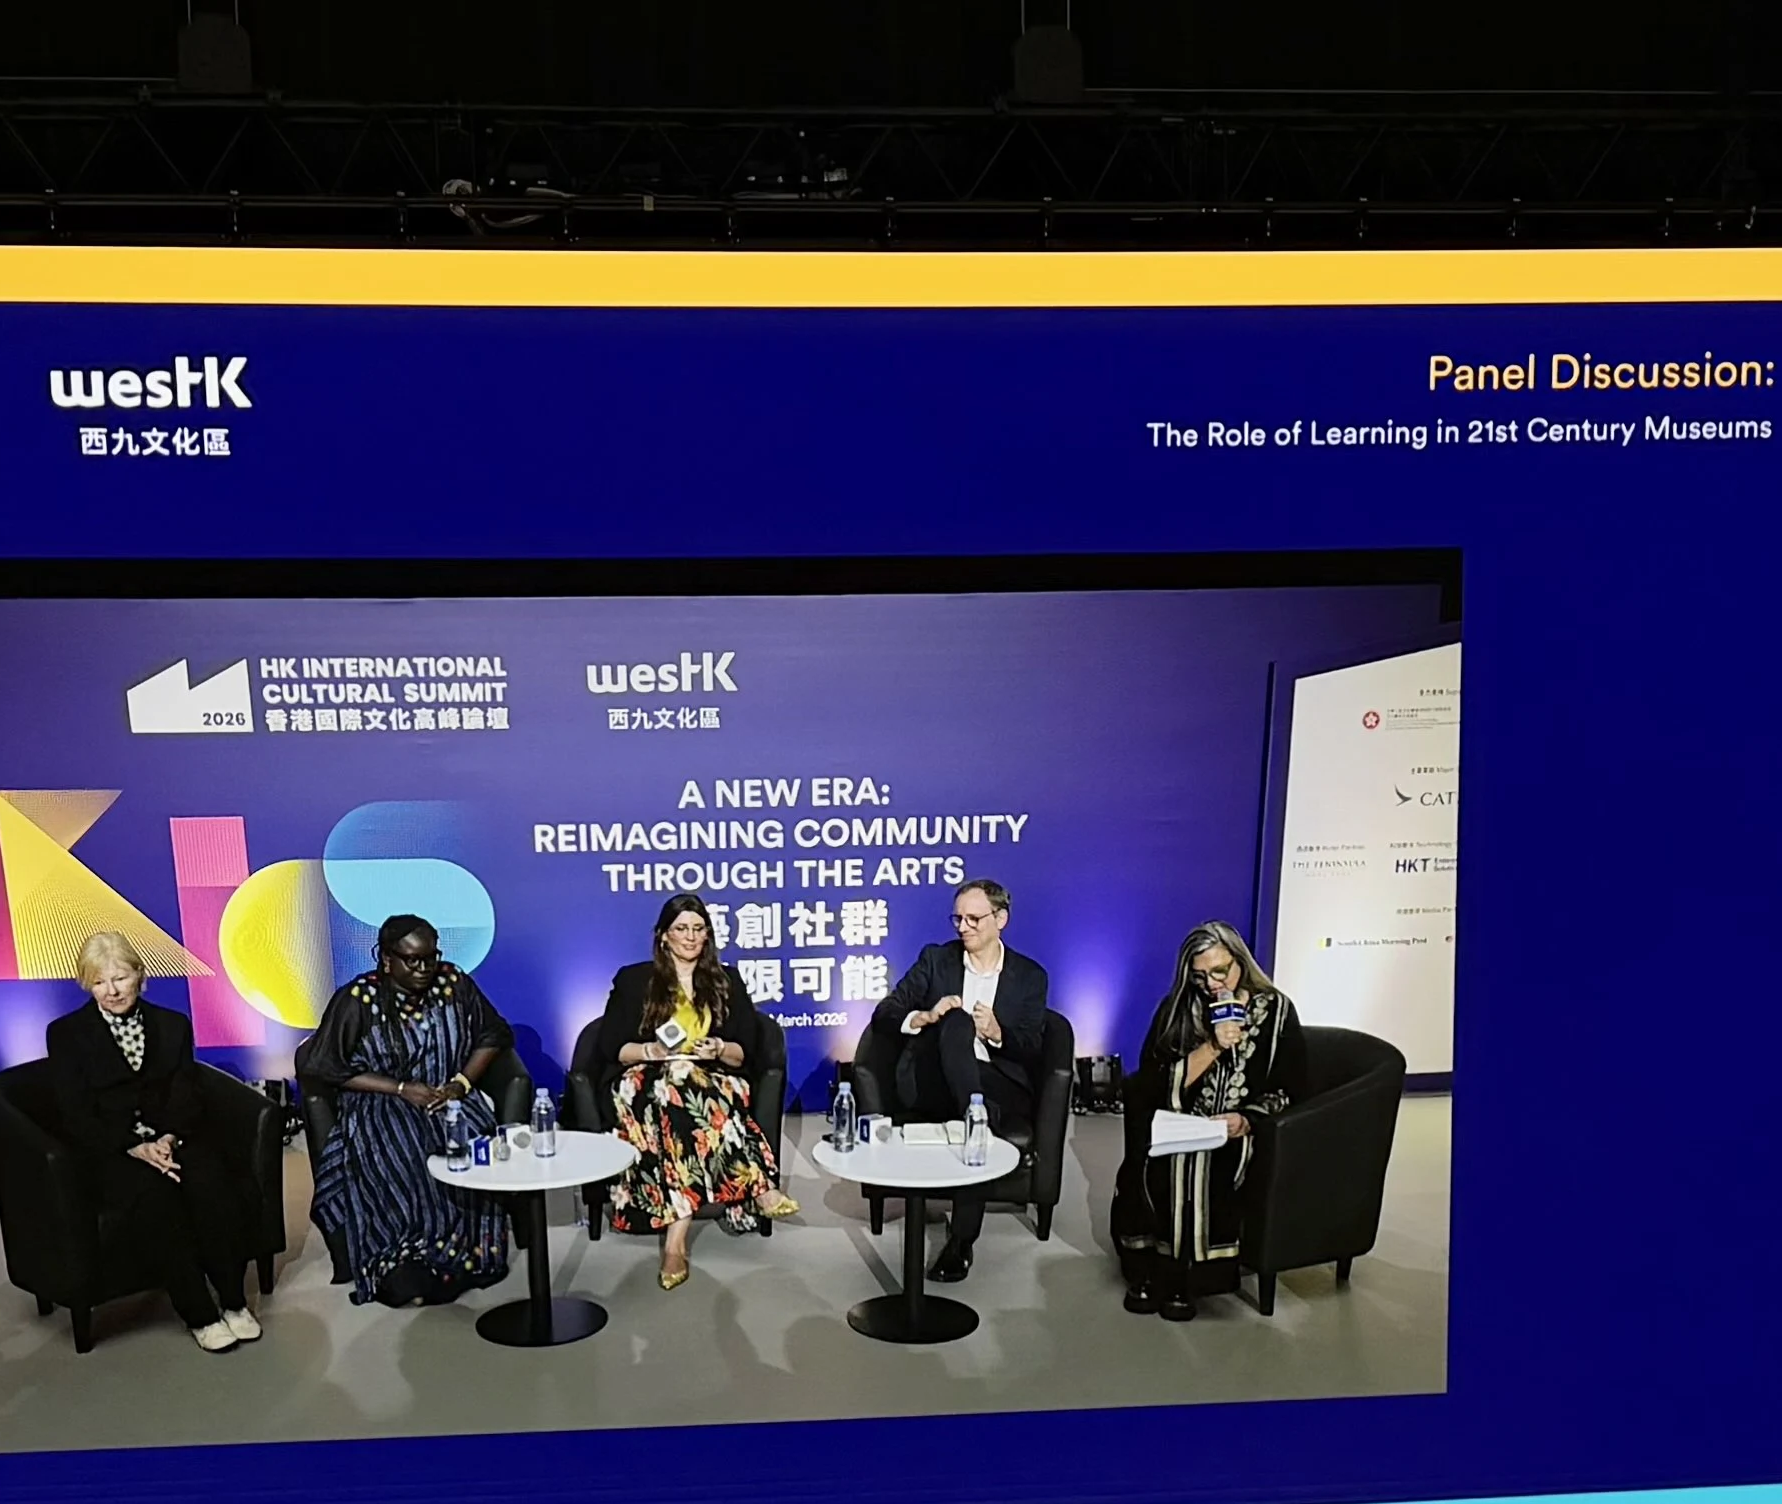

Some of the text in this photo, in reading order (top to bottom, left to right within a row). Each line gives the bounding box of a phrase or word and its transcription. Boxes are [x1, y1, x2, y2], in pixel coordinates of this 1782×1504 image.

[1430, 351, 1774, 390] Panel Discussion:
[80, 427, 230, 455] 西九文化區
[1147, 416, 1771, 449] The Role of Learning in 21st Century Museums
[260, 657, 507, 678] HK INTERNATIONAL
[263, 682, 507, 704] CULTURAL SUMMIT
[203, 713, 245, 726] 2026
[265, 707, 509, 732] 香港國際文化高峰論壇
[608, 707, 720, 729] 西九文化區
[678, 777, 889, 809] A NEW ERA:
[534, 815, 1028, 852] REIMAGINING COMMUNITY
[602, 856, 964, 891] THROUGH THE ARTS
[1396, 858, 1430, 873] HKT
[721, 955, 889, 1003] 限可能
[814, 1012, 848, 1026] 2026
